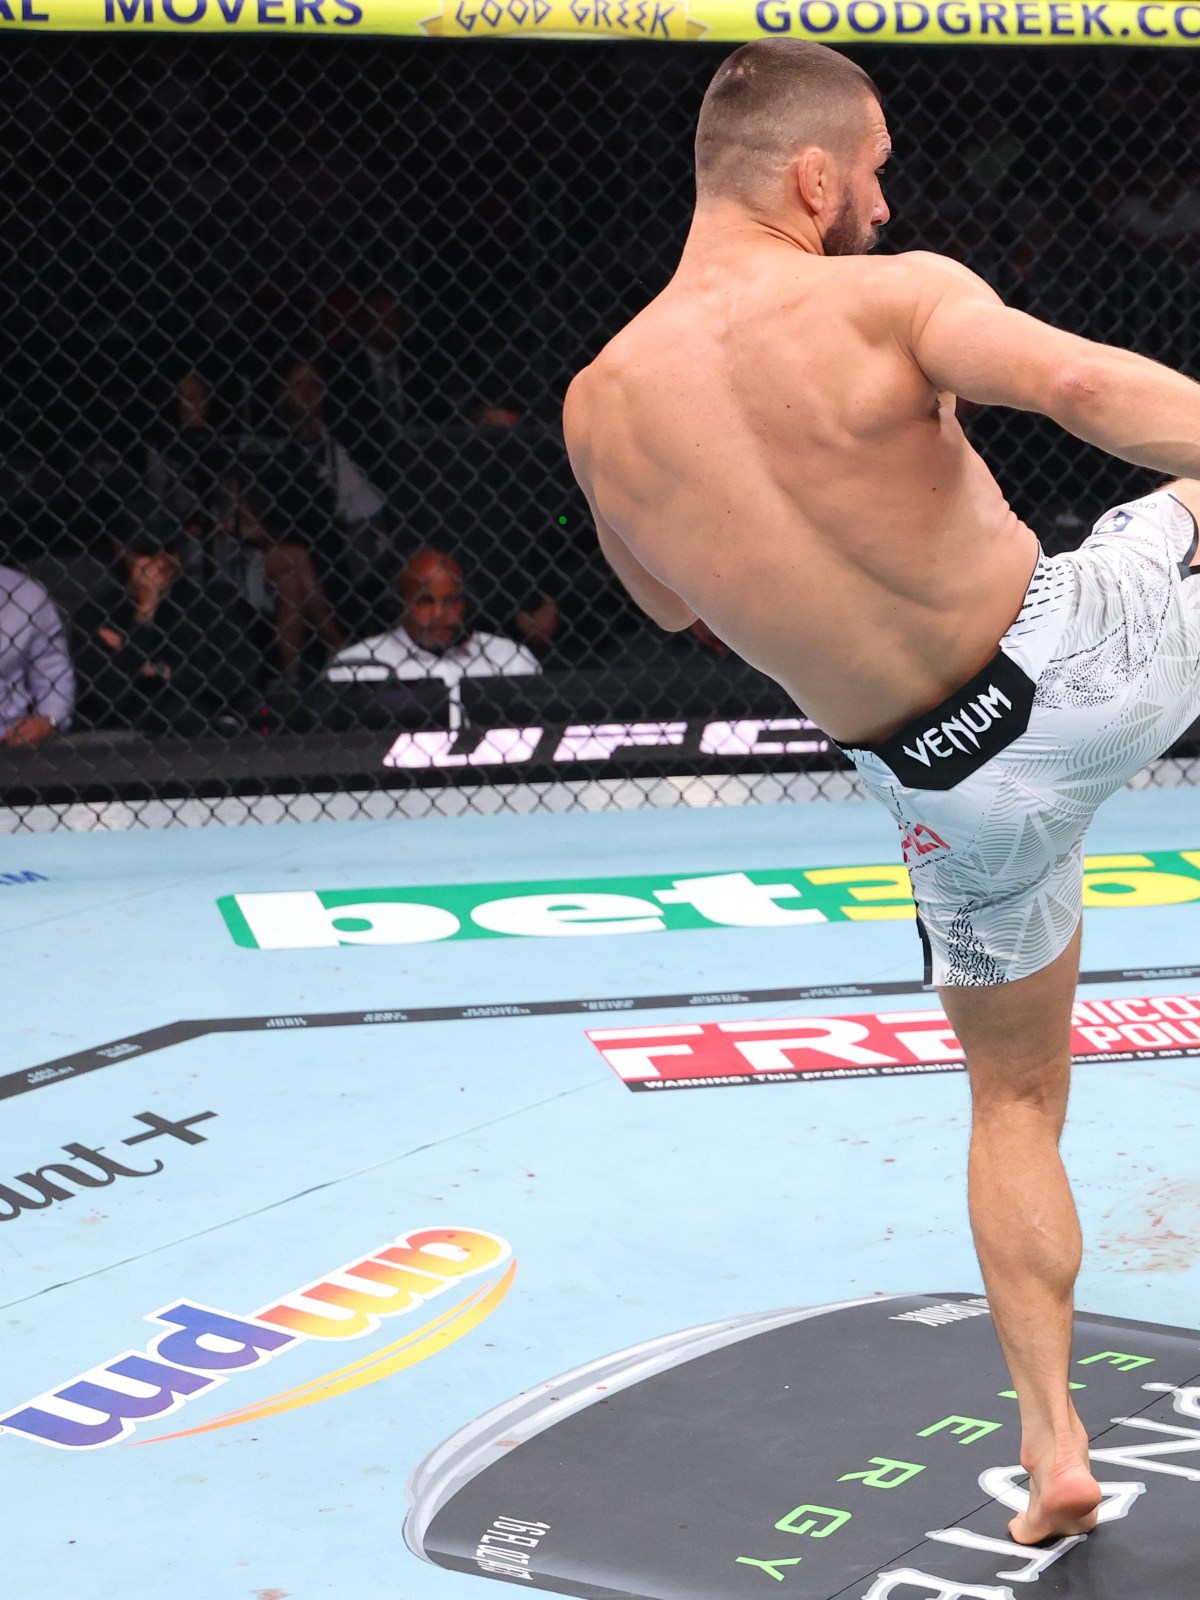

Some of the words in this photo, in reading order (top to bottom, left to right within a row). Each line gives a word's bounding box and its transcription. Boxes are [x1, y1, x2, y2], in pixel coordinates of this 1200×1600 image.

[104, 0, 362, 25] MOVERS
[456, 0, 551, 31] GOOD
[570, 0, 675, 37] GREEK
[383, 719, 828, 770] UFC
[903, 684, 1012, 769] VENUM
[643, 1075, 749, 1089] WARNING:
[754, 1070, 798, 1083] This
[801, 1065, 877, 1080] product
[882, 1061, 966, 1075] contains
[1159, 1049, 1182, 1058] an
[735, 1351, 1155, 1581] EERGY
[493, 1515, 551, 1536] 16
